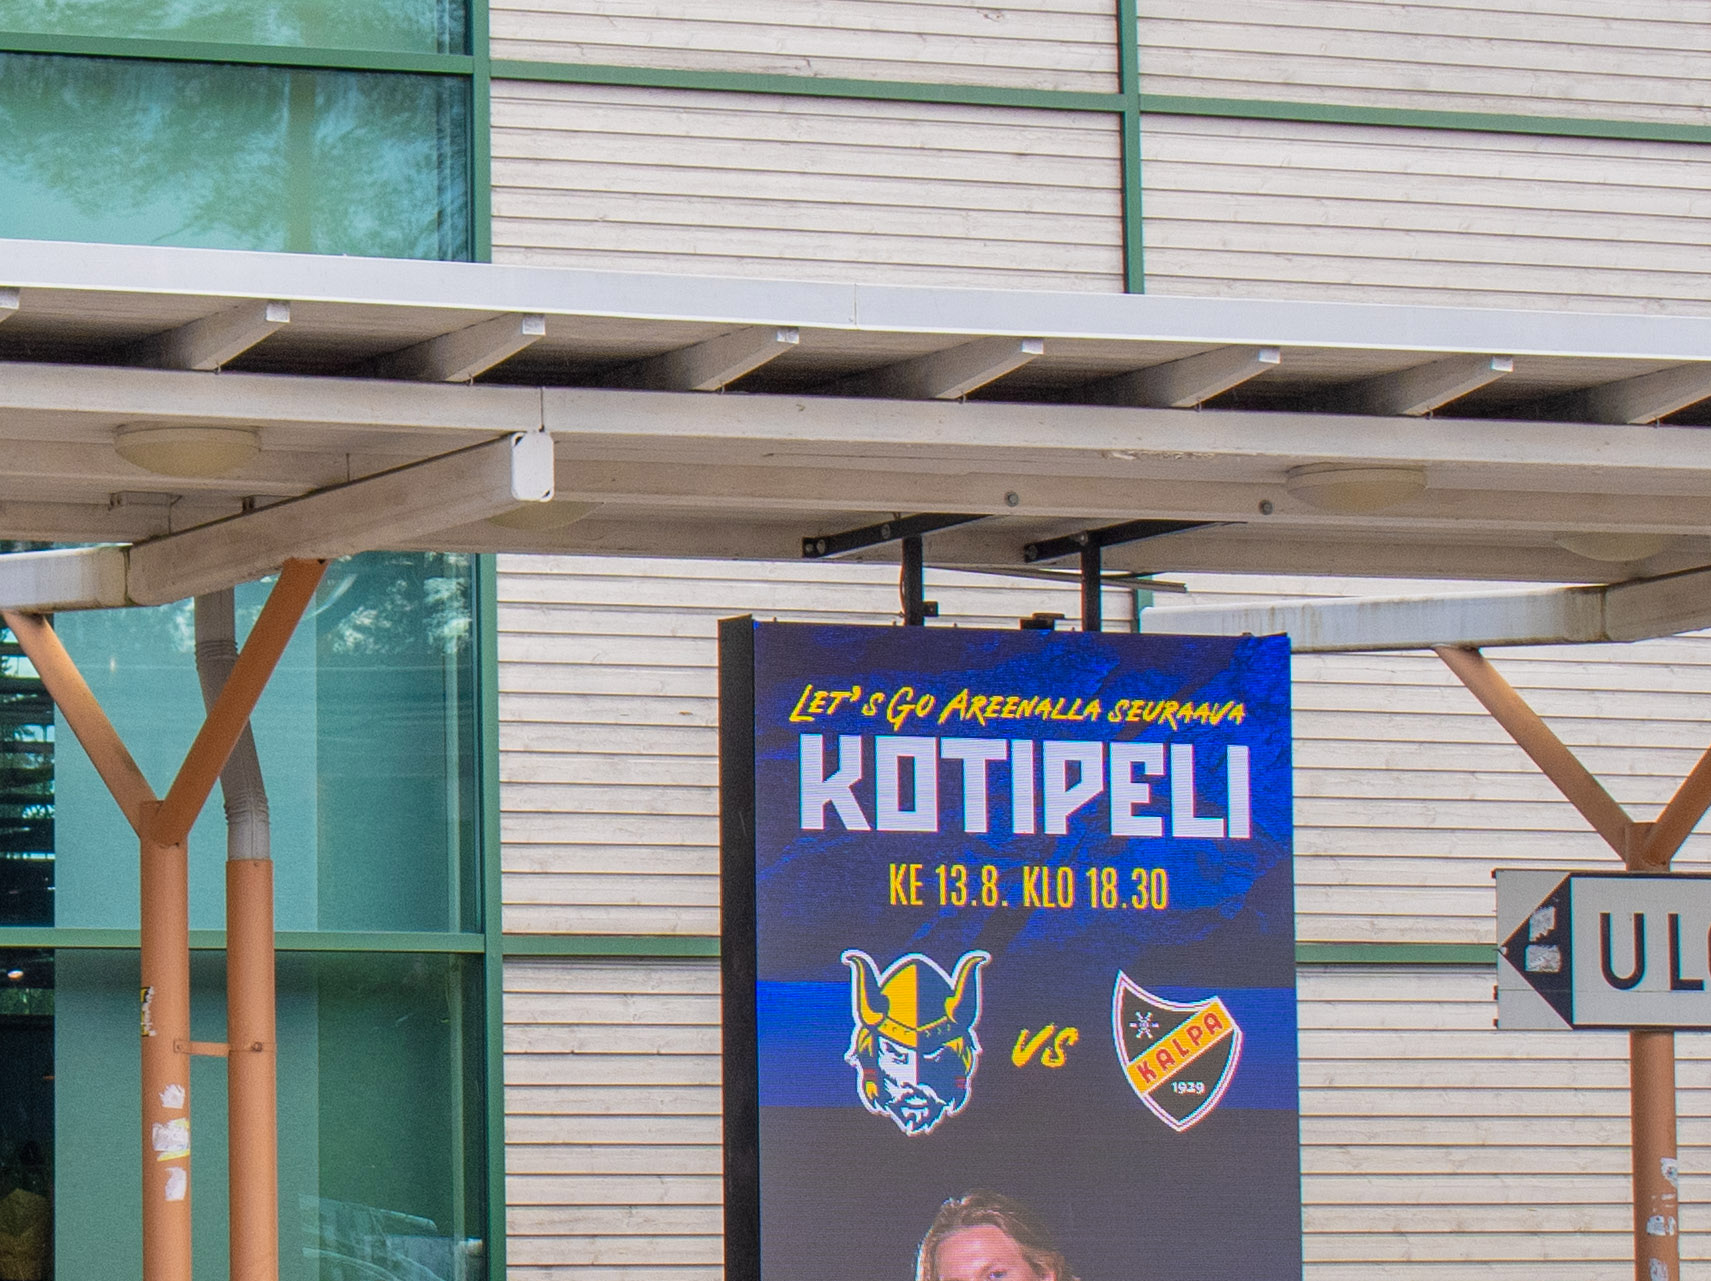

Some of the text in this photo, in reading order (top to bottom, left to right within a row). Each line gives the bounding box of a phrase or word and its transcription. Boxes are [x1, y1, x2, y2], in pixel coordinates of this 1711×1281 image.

[938, 688, 1101, 726] AREENALLA
[799, 733, 1252, 839] KOTIPELI
[889, 865, 1168, 909] KE 13.8. KLO 18.30
[1136, 1011, 1224, 1086] KALPA
[1171, 1080, 1205, 1094] 1929
